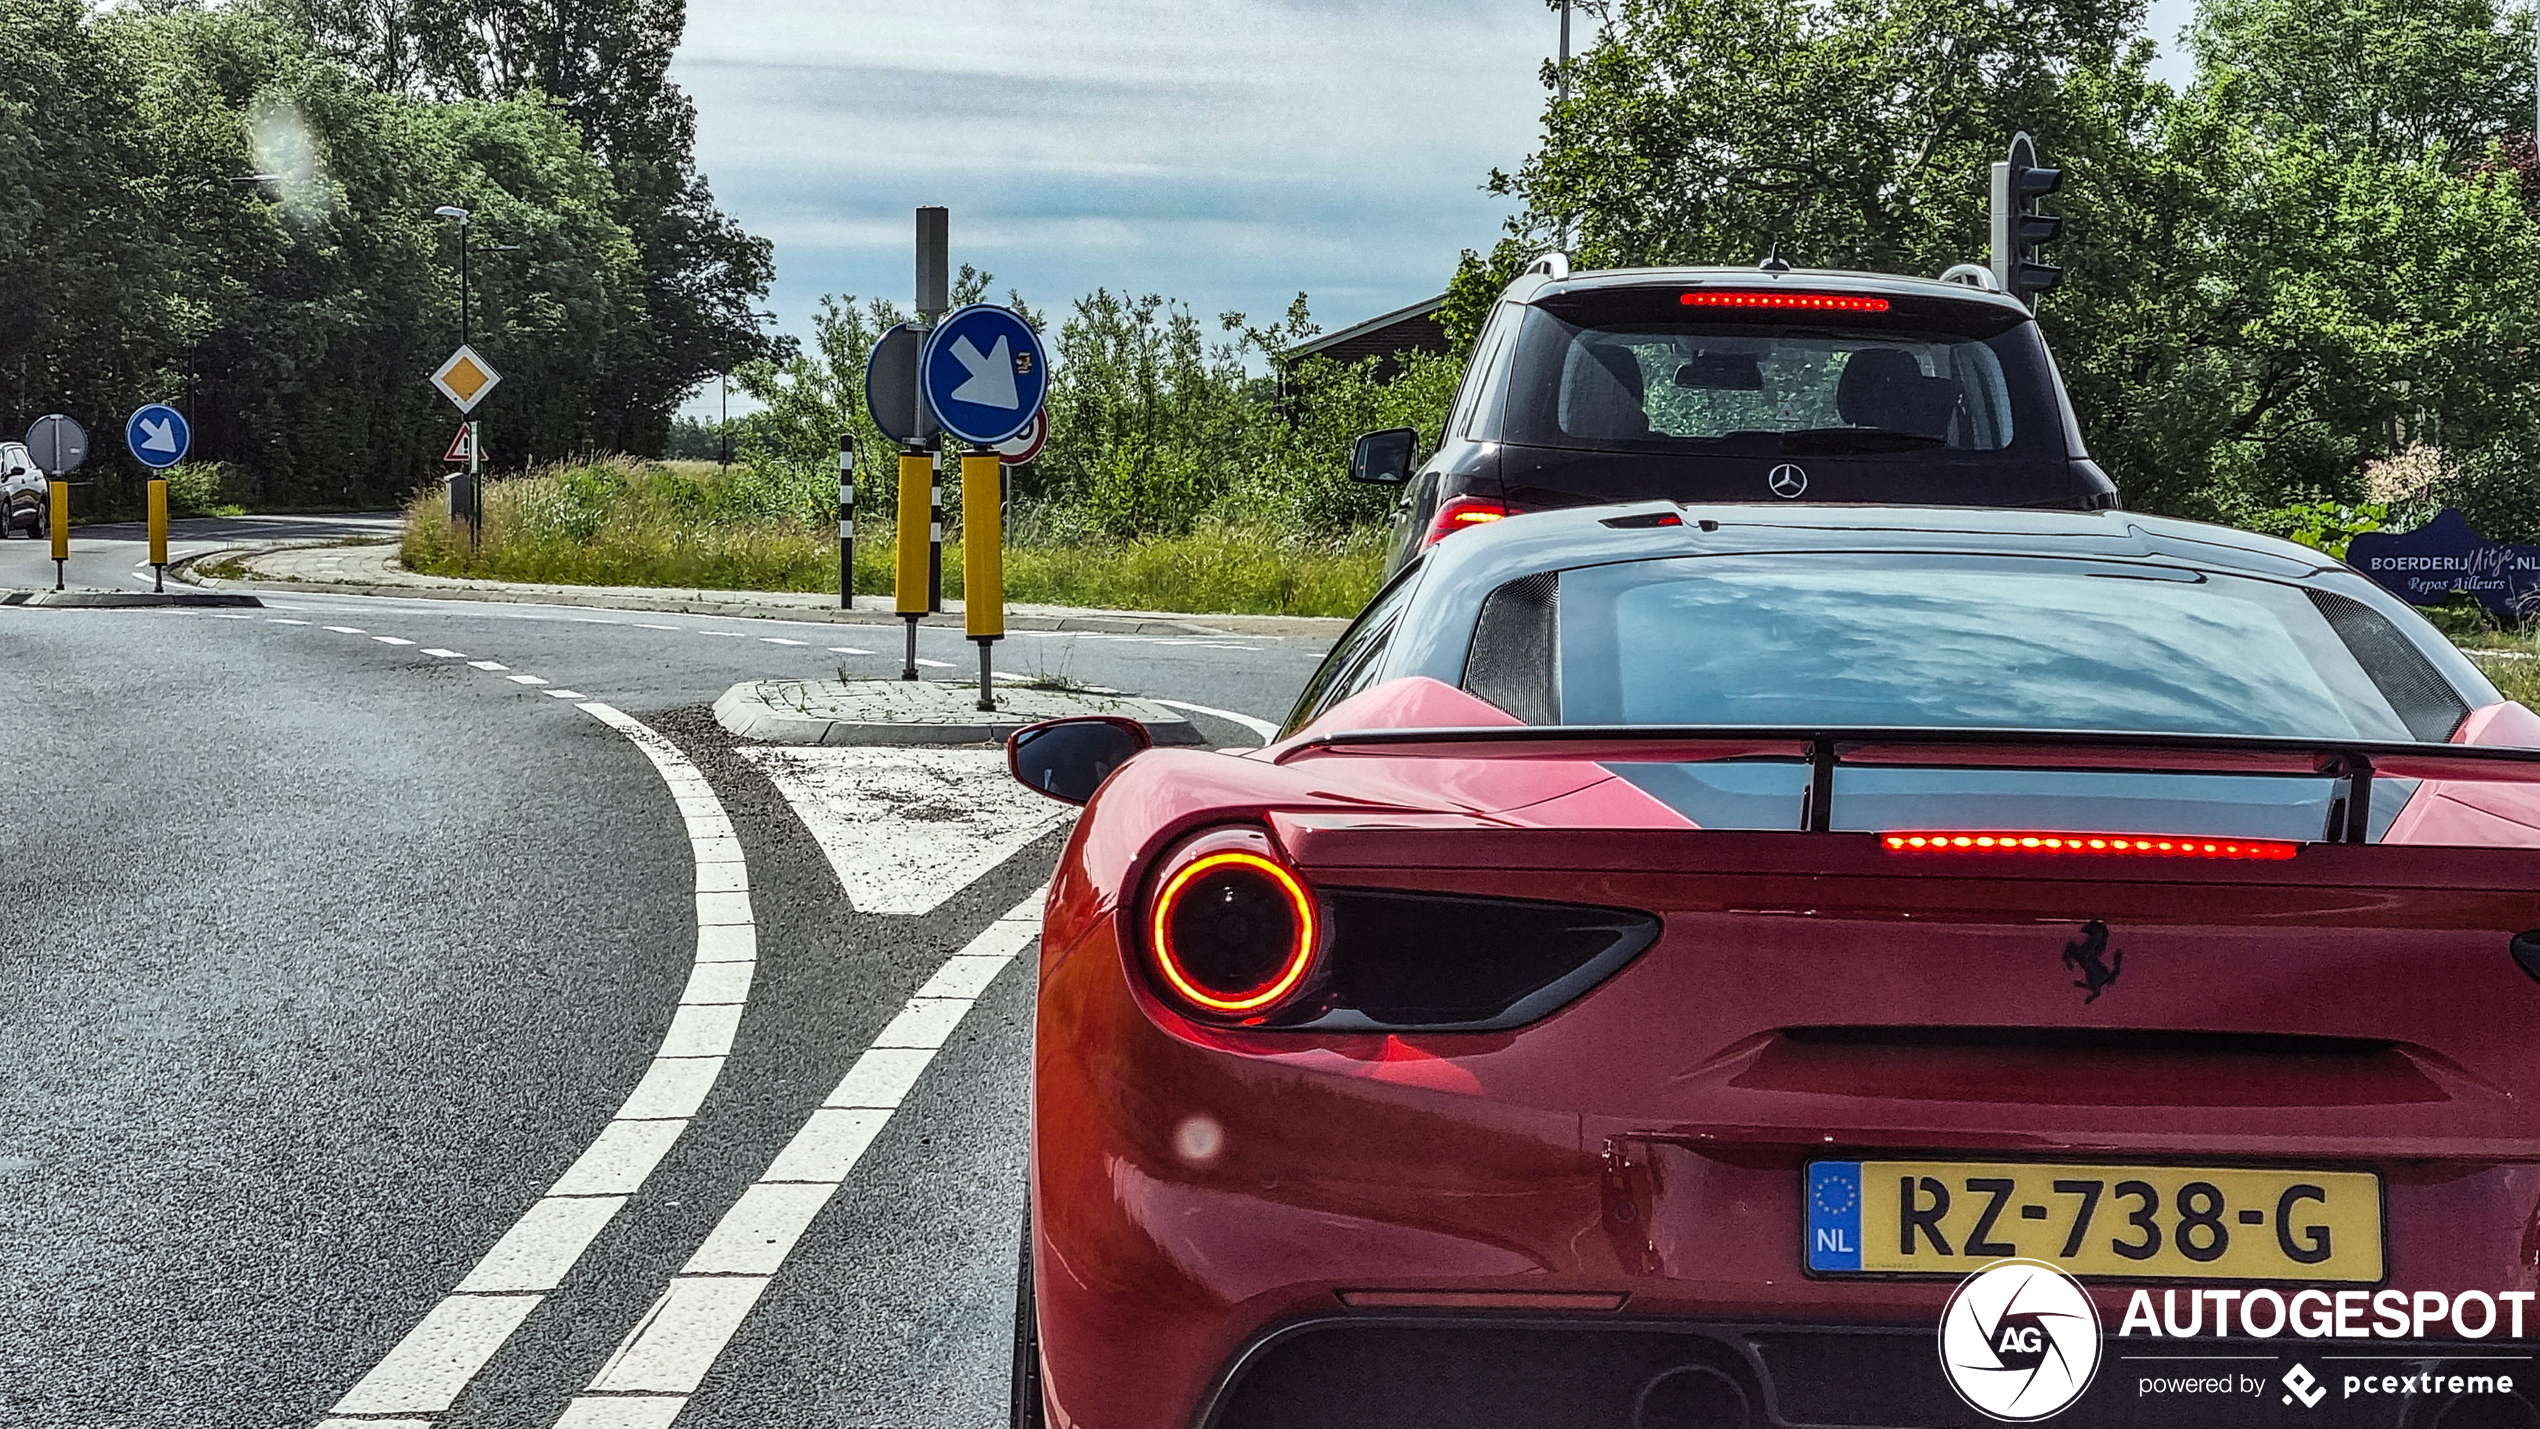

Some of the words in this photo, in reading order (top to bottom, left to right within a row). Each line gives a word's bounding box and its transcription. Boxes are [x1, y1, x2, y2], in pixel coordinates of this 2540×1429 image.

[2408, 576, 2449, 595] Repos
[2449, 576, 2506, 592] Ailleurs
[1900, 1175, 2333, 1265] RZ-738-G
[1817, 1228, 1853, 1253] NL
